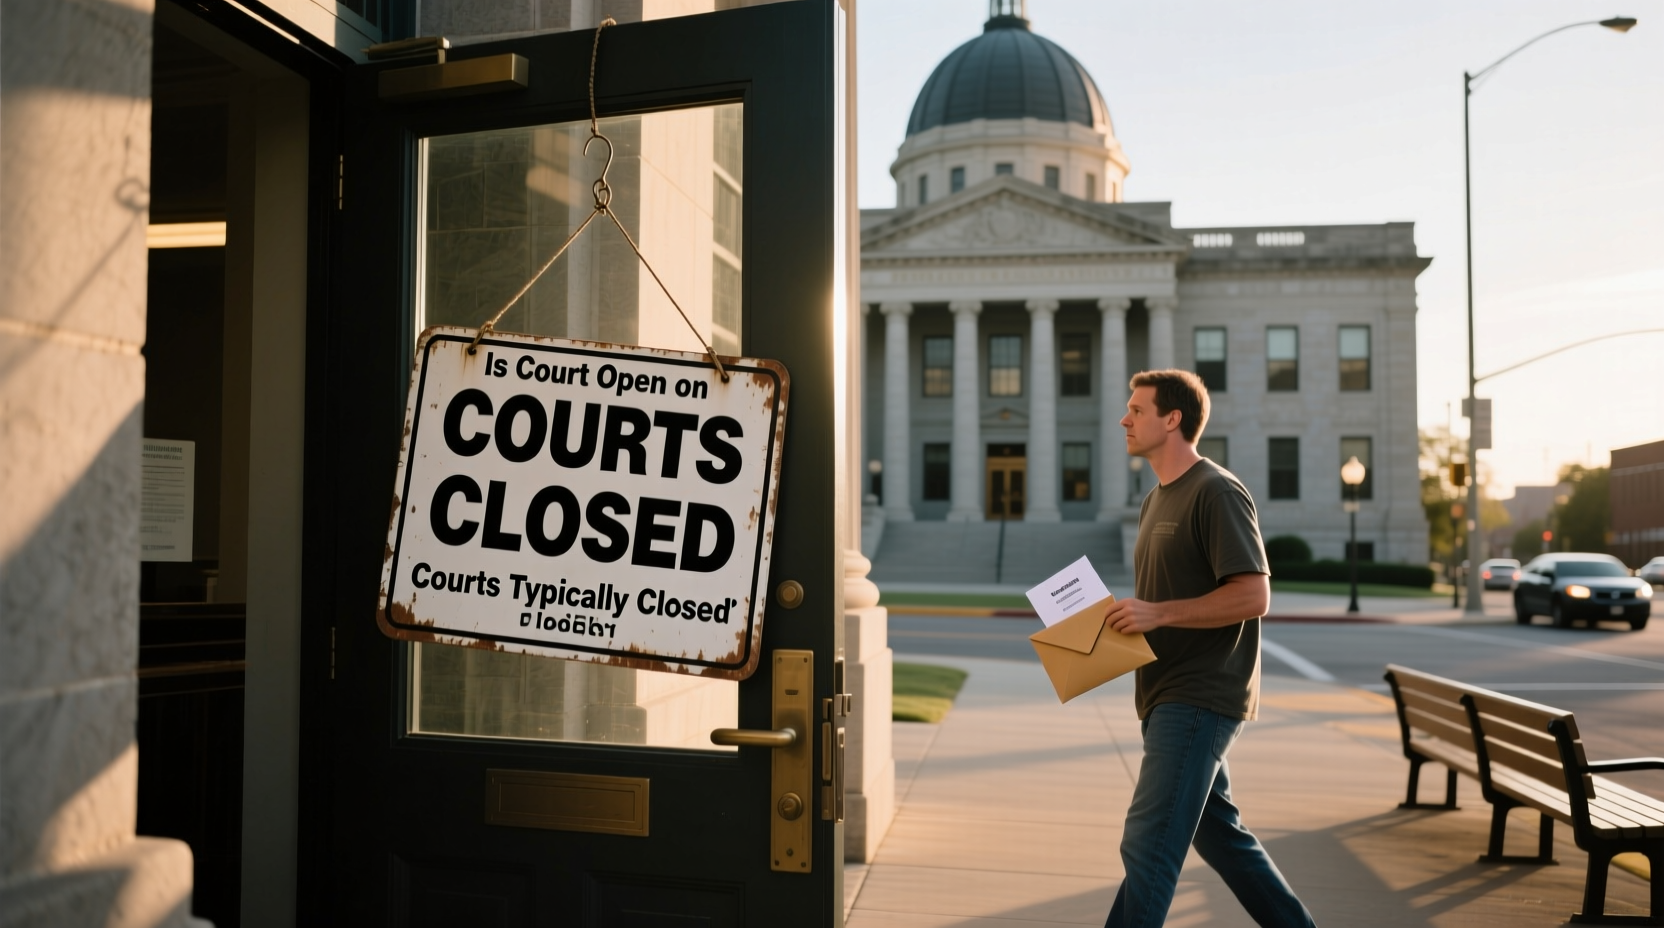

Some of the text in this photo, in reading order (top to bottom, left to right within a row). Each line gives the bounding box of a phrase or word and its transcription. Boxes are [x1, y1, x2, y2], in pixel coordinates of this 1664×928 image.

[484, 351, 708, 400] Is Court Open on
[443, 387, 744, 485] COURTS
[429, 474, 736, 573] CLOSED
[411, 562, 501, 598] Courts
[509, 573, 630, 619] Typically
